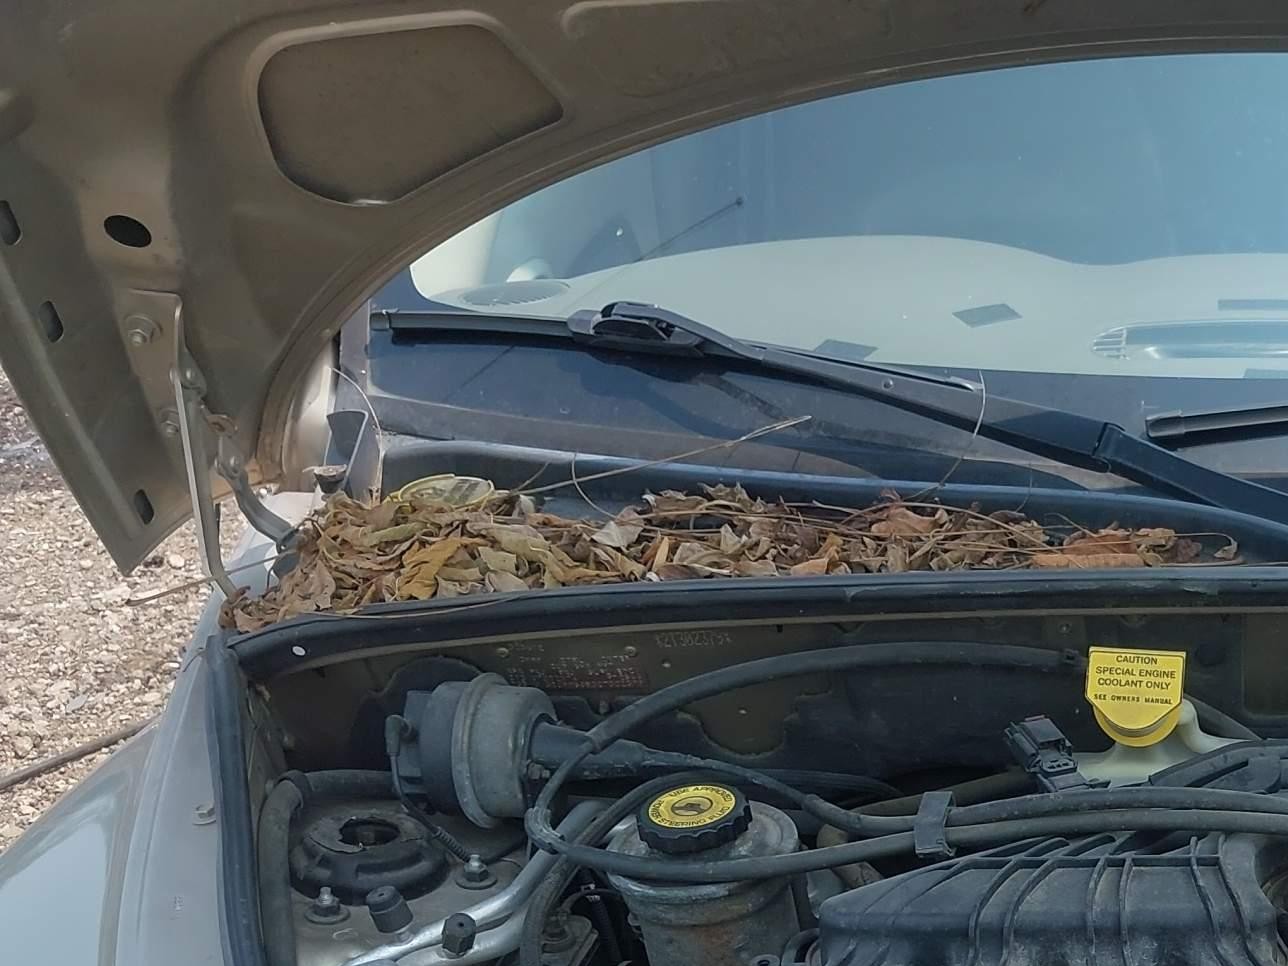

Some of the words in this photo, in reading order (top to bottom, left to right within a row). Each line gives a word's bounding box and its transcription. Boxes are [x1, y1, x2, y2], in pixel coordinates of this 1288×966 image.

[1115, 655, 1158, 665] CAUTION
[1095, 666, 1137, 677] SPECIAL
[1138, 669, 1176, 679] ENGINE
[1097, 677, 1143, 689] COOLANT
[1145, 680, 1171, 690] ONLY
[1111, 695, 1140, 703] OWNERS
[1144, 697, 1172, 705] MANUAL
[658, 817, 707, 827] STEERING
